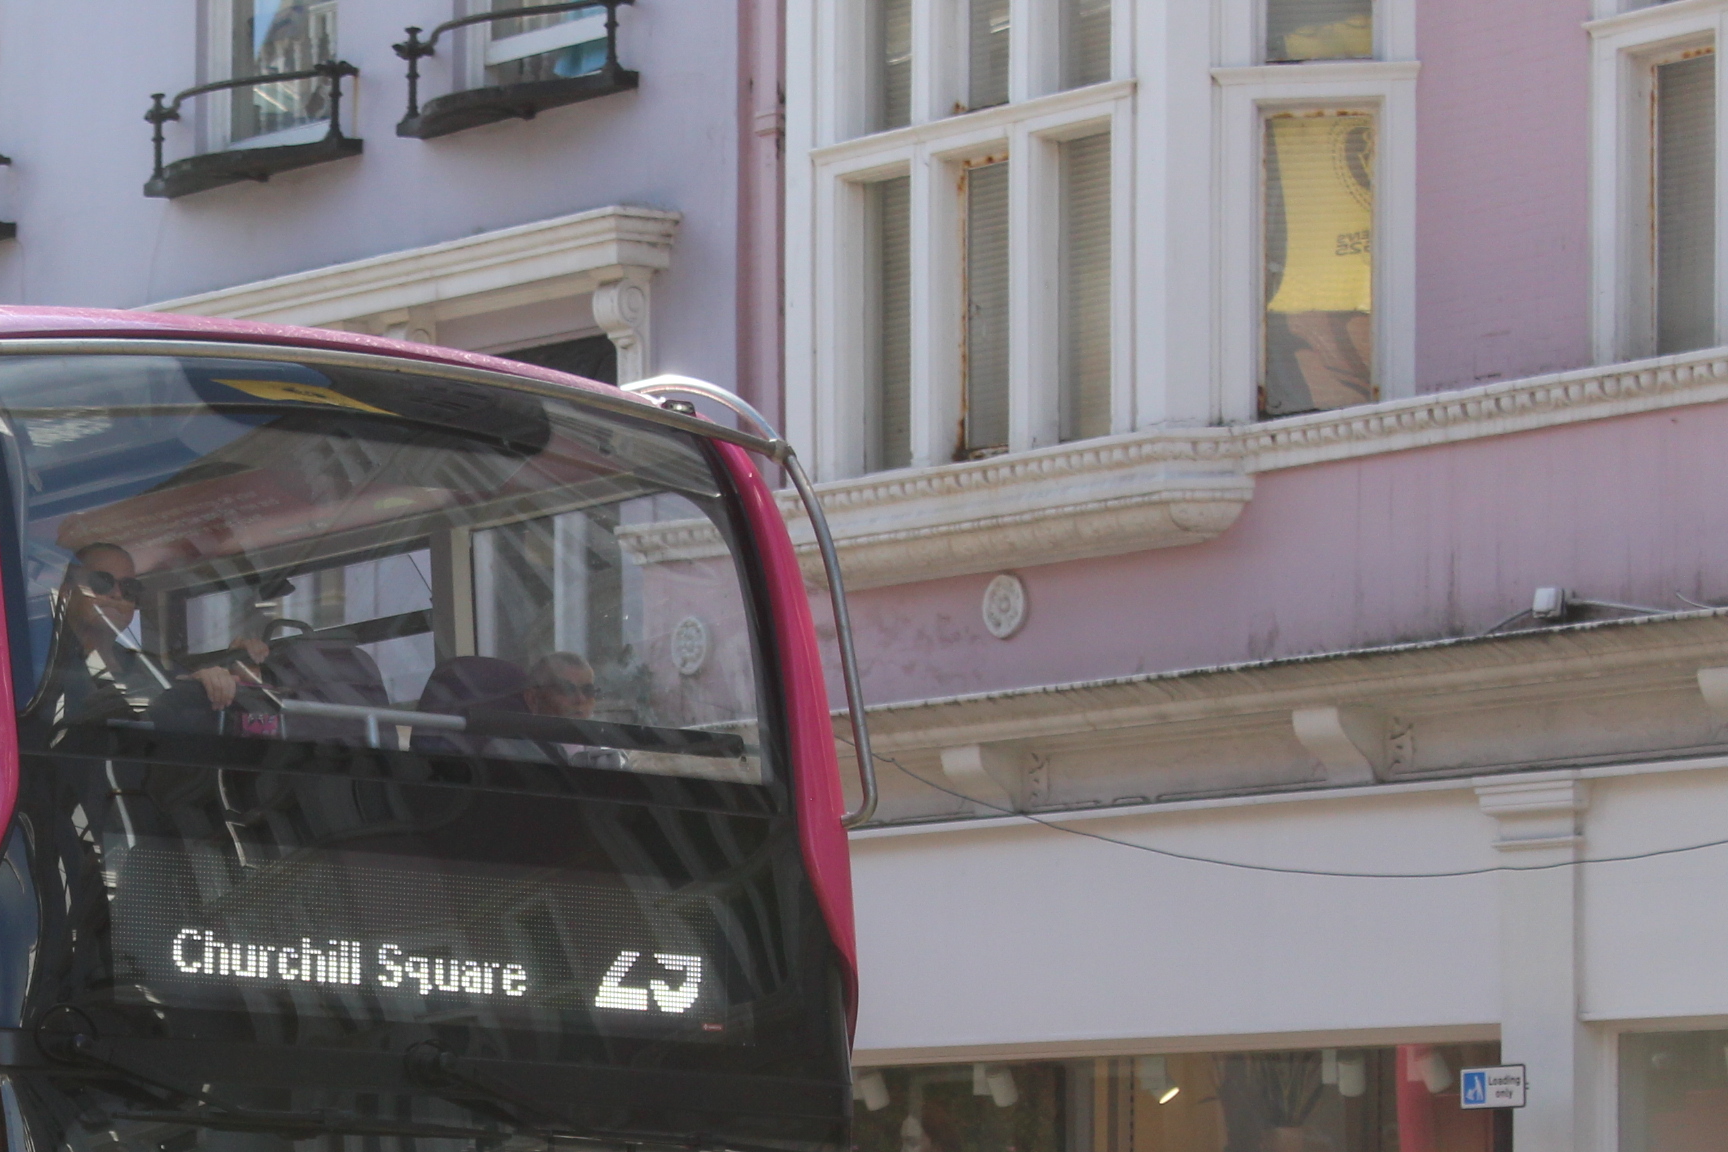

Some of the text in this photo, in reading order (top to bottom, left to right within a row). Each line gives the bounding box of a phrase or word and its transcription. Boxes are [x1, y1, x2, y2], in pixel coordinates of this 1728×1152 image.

[172, 928, 528, 997] Churchill Square
[1488, 1075, 1521, 1086] Loading
[1495, 1088, 1512, 1099] only
